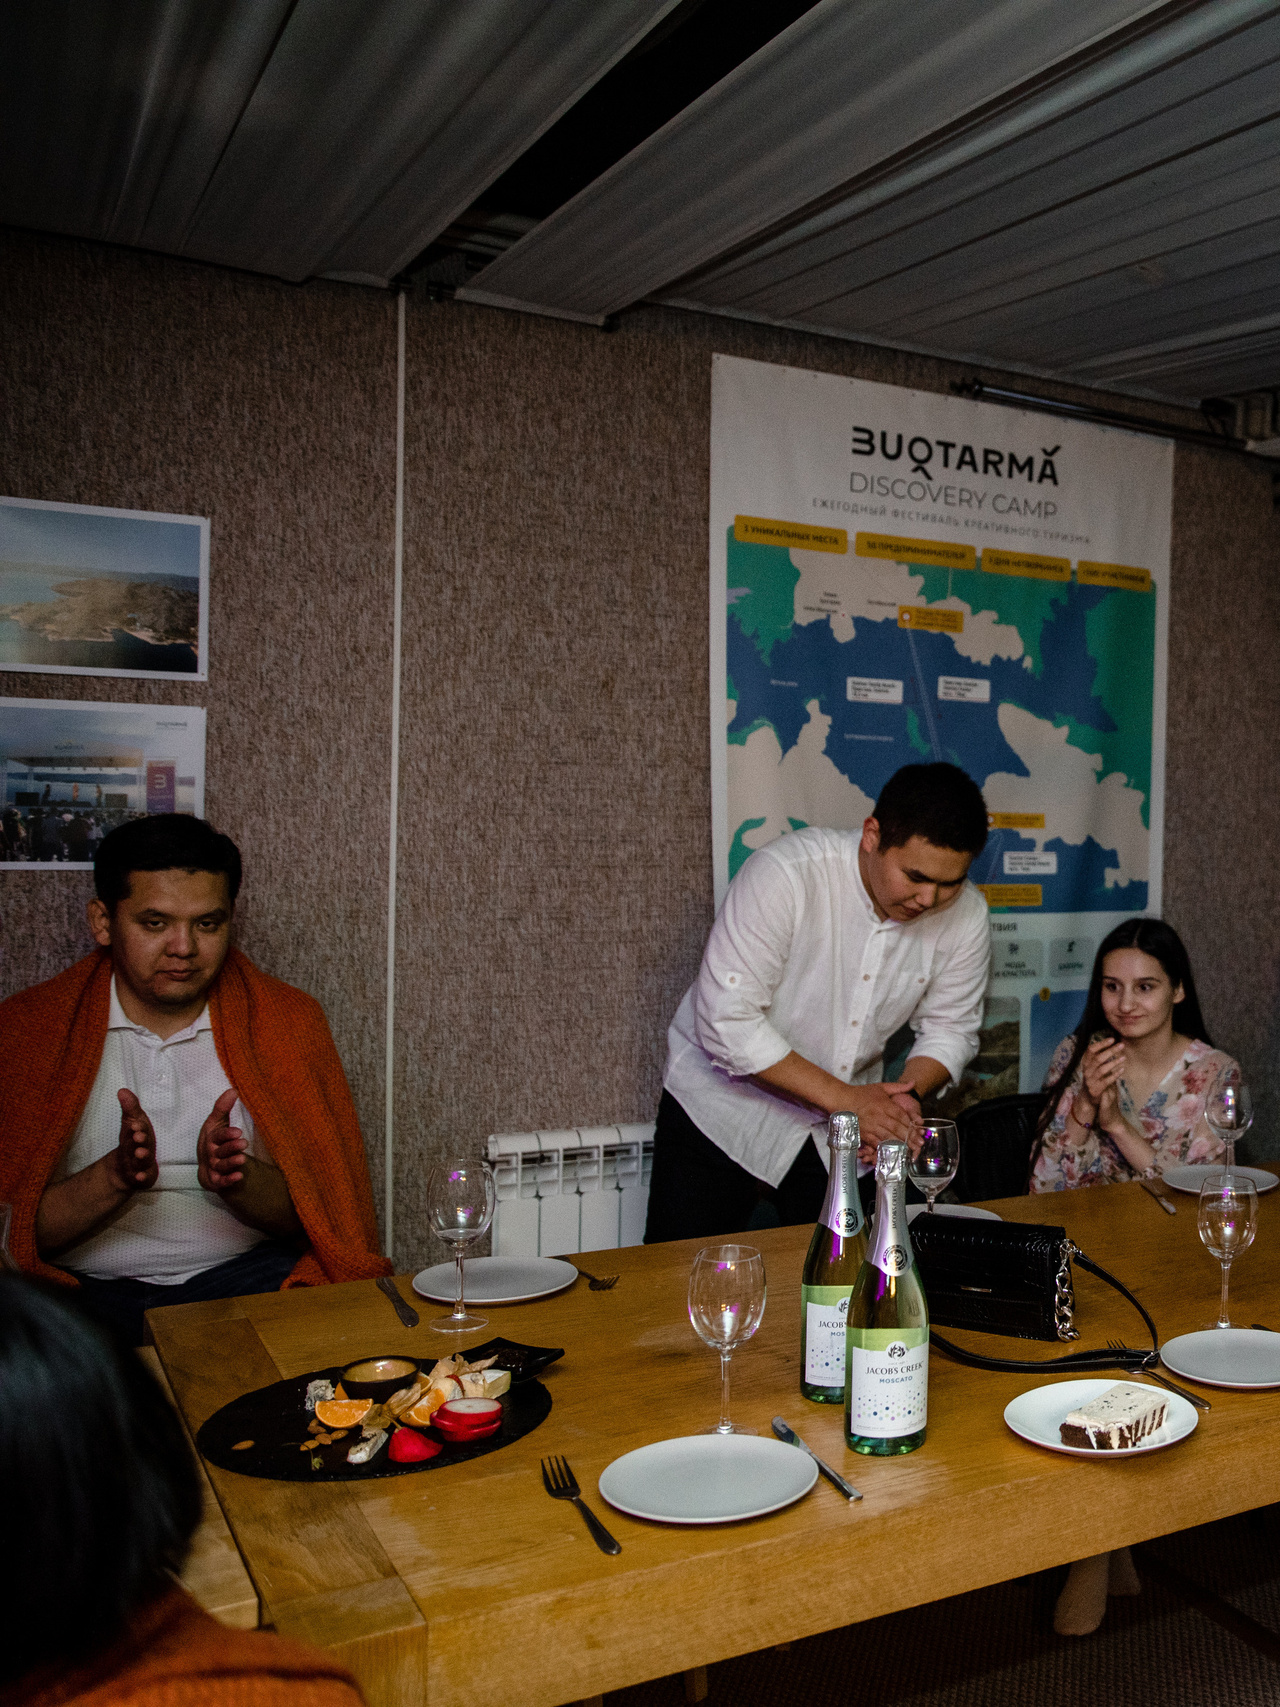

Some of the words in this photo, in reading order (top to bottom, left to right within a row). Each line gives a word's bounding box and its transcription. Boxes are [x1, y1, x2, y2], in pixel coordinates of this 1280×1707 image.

[849, 471, 987, 510] DISCOVERY
[991, 494, 1059, 519] CAMP
[812, 497, 886, 516] ЕЖЕГОДНЫЙ
[891, 508, 960, 527] ФЕСТИВАЛЬ
[964, 518, 1039, 539] КРЕАТИВНОГО
[1042, 529, 1091, 545] ТУРИЗМА
[750, 525, 811, 541] УНИКАЛЬНЫХ
[812, 534, 839, 545] МЕСТА
[900, 1363, 923, 1374] CREEK
[879, 1375, 914, 1384] MOSCATO
